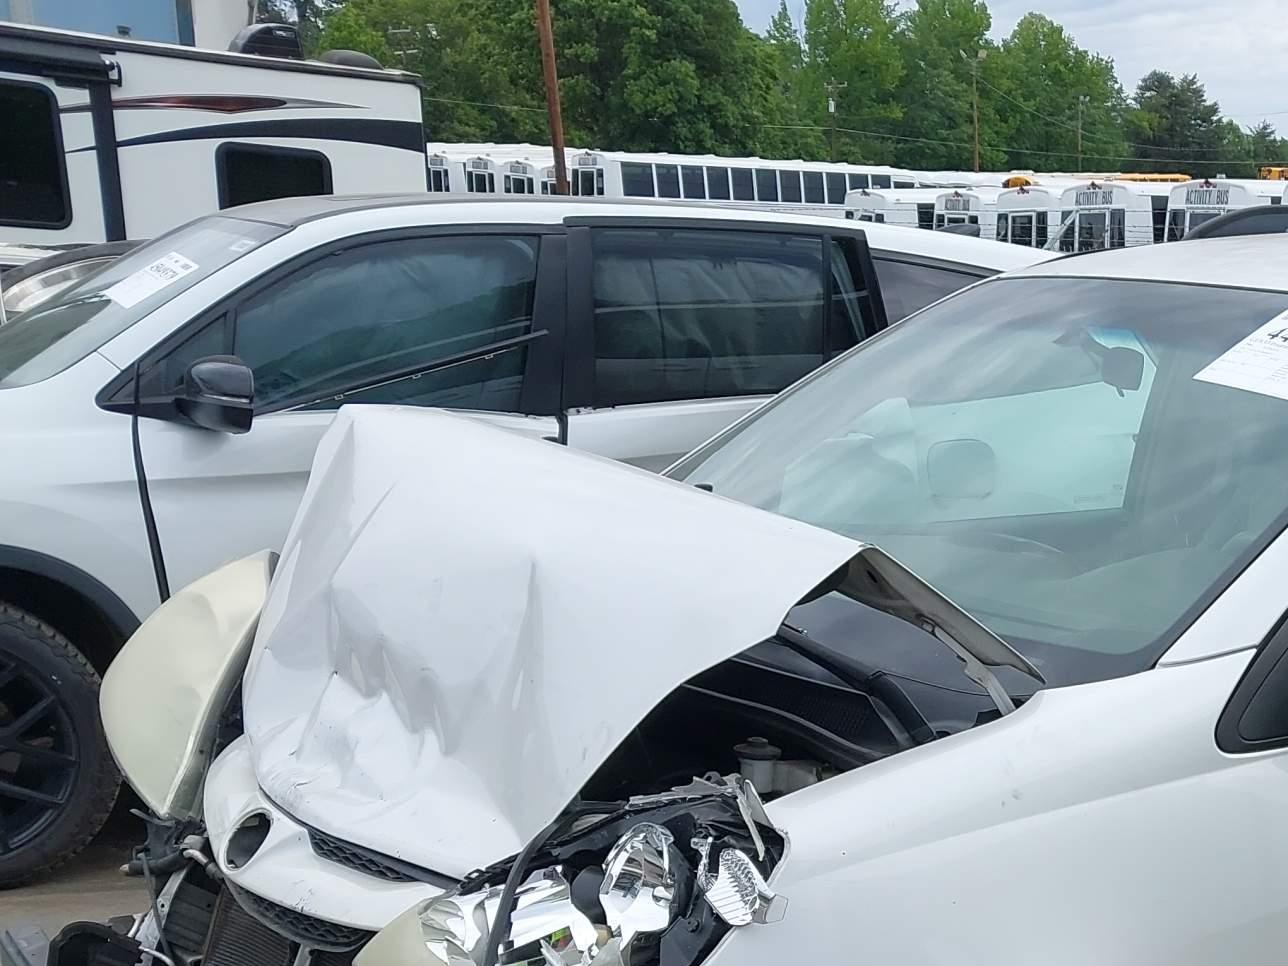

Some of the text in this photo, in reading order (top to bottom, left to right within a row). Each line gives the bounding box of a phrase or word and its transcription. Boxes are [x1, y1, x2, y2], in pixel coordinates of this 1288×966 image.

[1075, 191, 1113, 206] ACTIVITY BUS
[1185, 189, 1229, 205] ACTIVITY BUS
